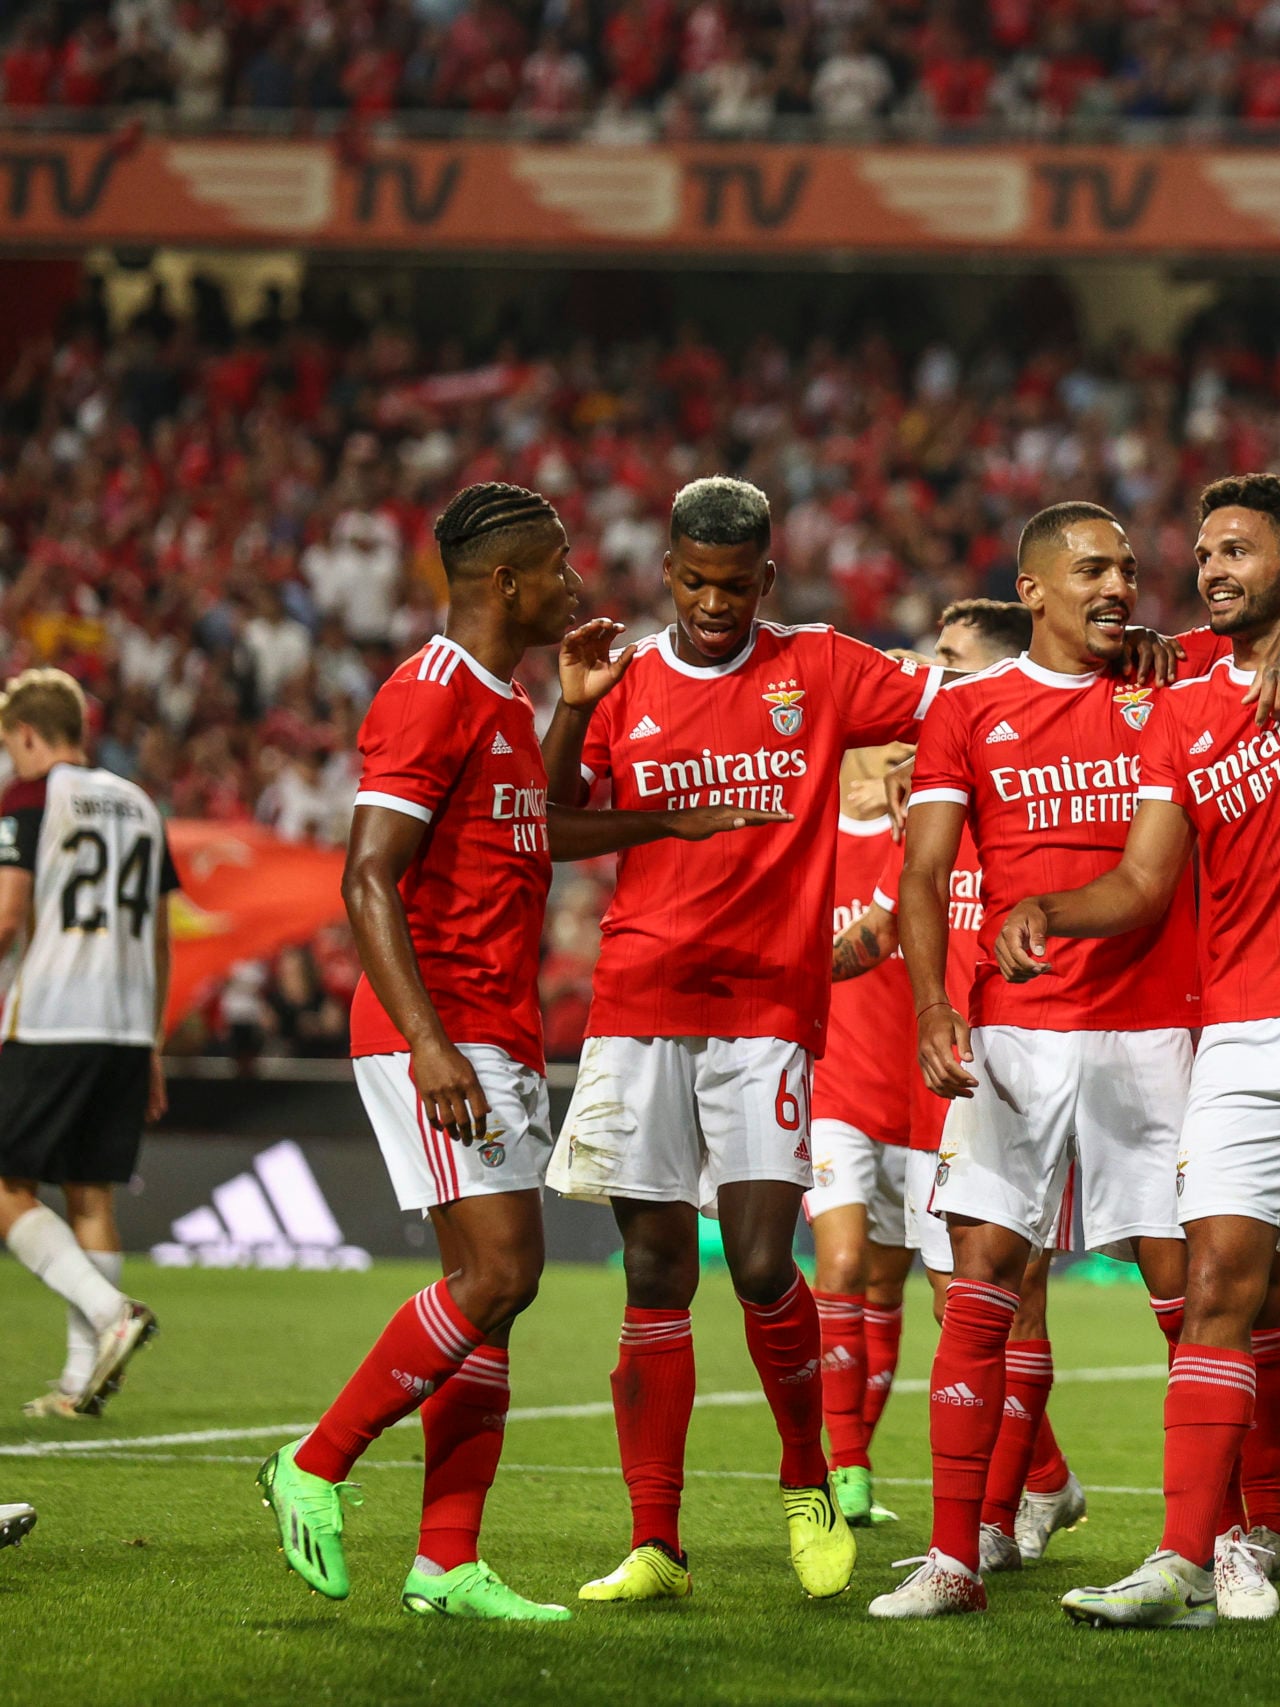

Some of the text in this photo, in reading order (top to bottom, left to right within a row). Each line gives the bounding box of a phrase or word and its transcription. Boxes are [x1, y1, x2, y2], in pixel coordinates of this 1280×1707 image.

[0, 152, 115, 219] TV
[352, 157, 461, 224] TV
[692, 162, 810, 228] TV
[1036, 163, 1157, 231] TV
[629, 726, 662, 741] adidas
[985, 733, 1020, 744] adidas
[632, 746, 807, 798] Emirates
[990, 752, 1141, 802] Emirate
[1027, 798, 1061, 831] FLY
[1216, 783, 1247, 823] FLY
[513, 824, 536, 852] FLY
[61, 828, 153, 938] 24
[775, 1069, 800, 1131] 6
[931, 1393, 984, 1407] adidas
